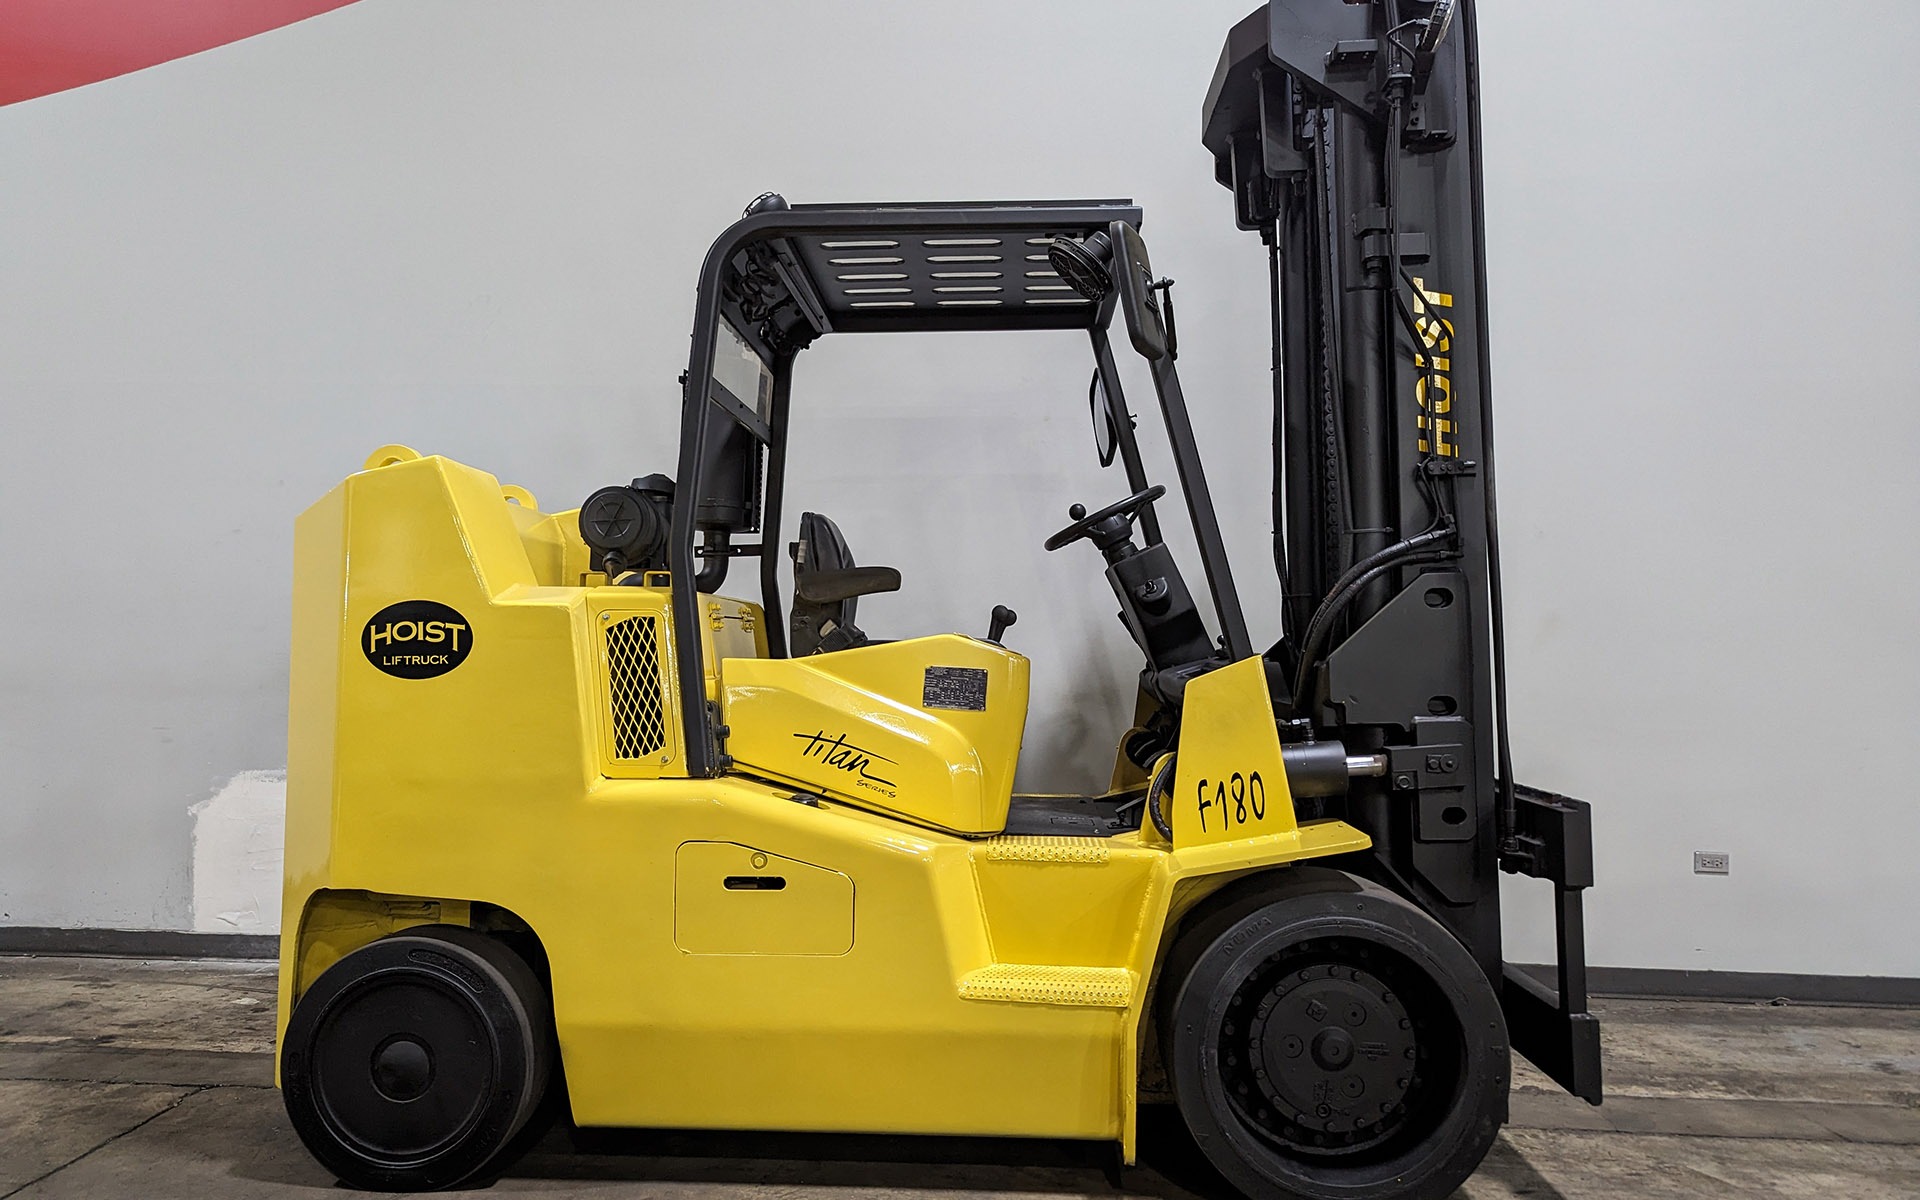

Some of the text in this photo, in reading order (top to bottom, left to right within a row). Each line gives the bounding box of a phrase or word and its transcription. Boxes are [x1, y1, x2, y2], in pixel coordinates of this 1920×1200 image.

[1413, 276, 1459, 459] HOIST
[370, 620, 466, 654] HOIST
[383, 654, 449, 666] LIFTRUCK
[1197, 770, 1265, 833] F180
